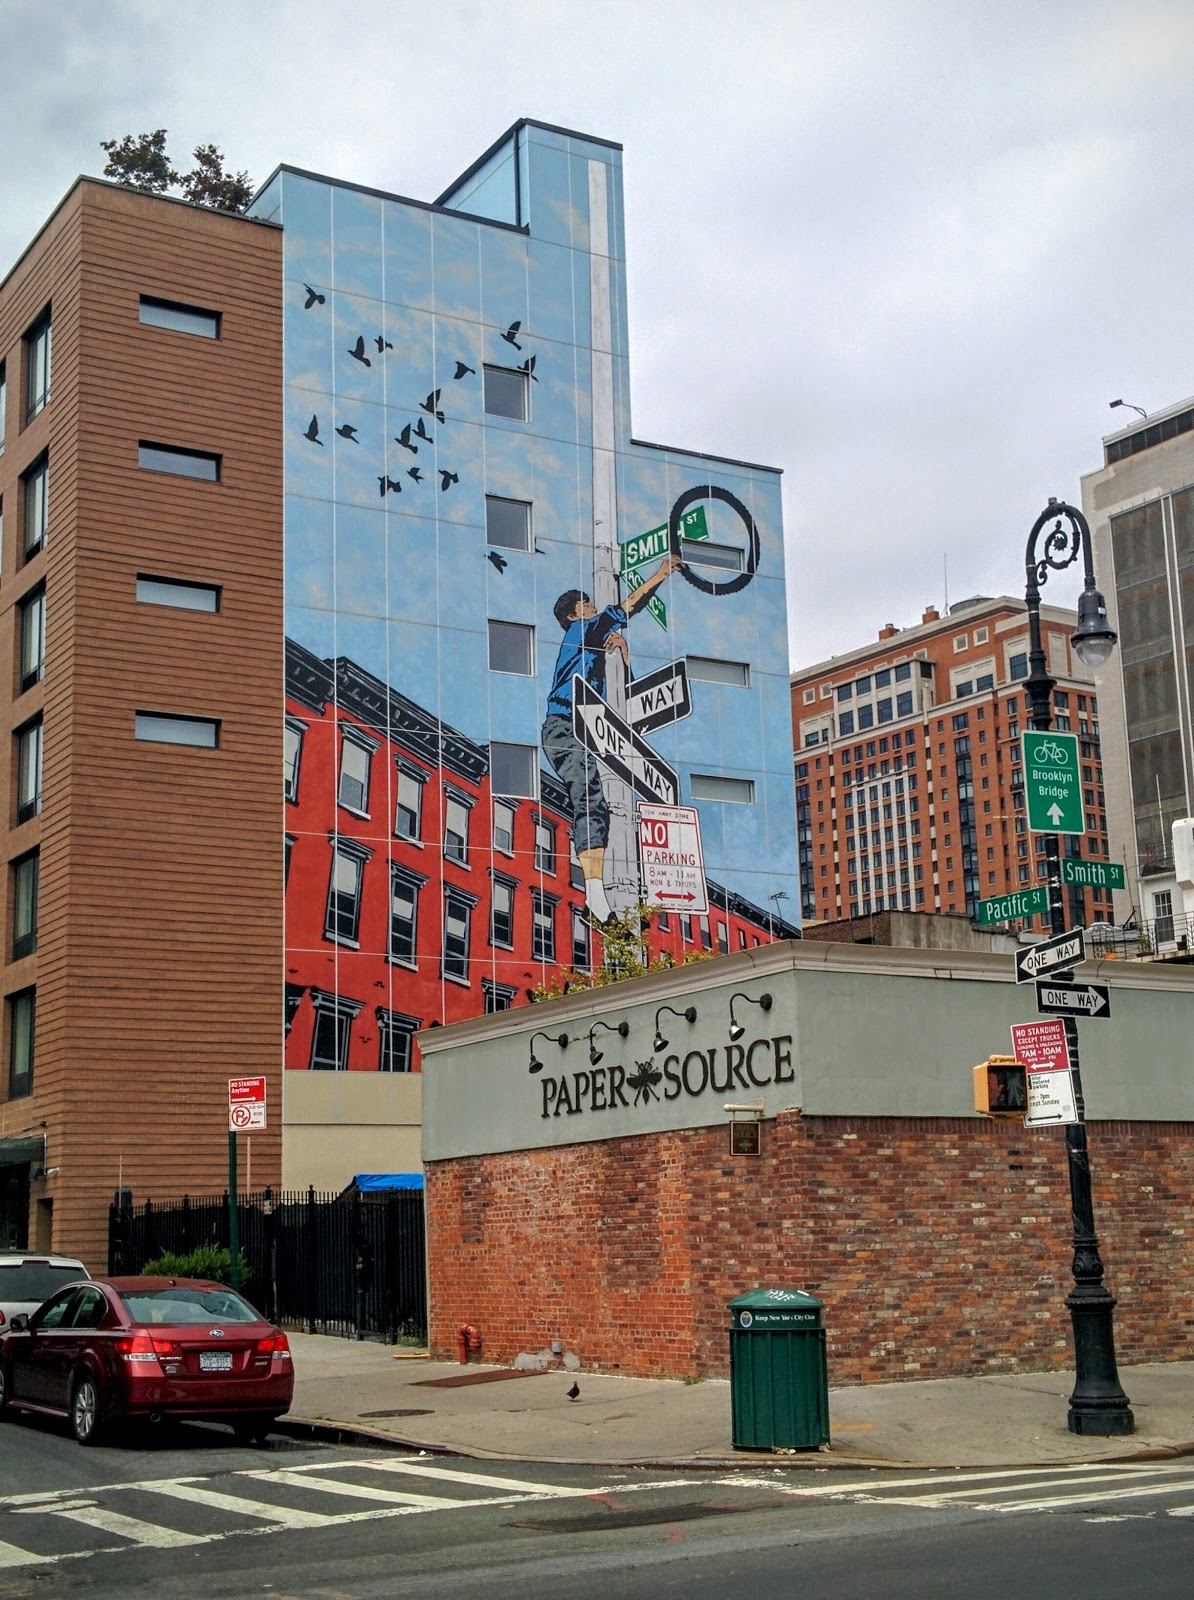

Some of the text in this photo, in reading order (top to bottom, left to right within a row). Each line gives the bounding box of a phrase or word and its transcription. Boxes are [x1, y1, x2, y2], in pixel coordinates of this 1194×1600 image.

[686, 513, 698, 525] ST
[640, 679, 677, 715] WAY
[595, 715, 671, 803] ONE WAY
[1032, 769, 1073, 784] Brooklyn
[1038, 785, 1069, 799] Bridge
[641, 821, 667, 845] NO
[647, 850, 696, 866] PARKING
[1066, 862, 1119, 884] Smith St
[649, 878, 663, 886] MON
[986, 891, 1041, 921] Pacific St
[1027, 952, 1048, 970] ONE
[1056, 941, 1076, 960] WAY
[1047, 991, 1098, 1008] ONE WAY
[1016, 1025, 1060, 1037] NO STANDING
[1017, 1034, 1060, 1045] EXCEPT TRUCKS
[1017, 1043, 1035, 1051] LOADING
[1040, 1040, 1063, 1048] UNLOADING
[1020, 1049, 1037, 1058] 7AM
[1042, 1046, 1062, 1056] 10AM
[540, 1035, 795, 1118] PAPER SOURCE
[754, 1314, 769, 1322] Keep
[793, 1314, 804, 1322] City
